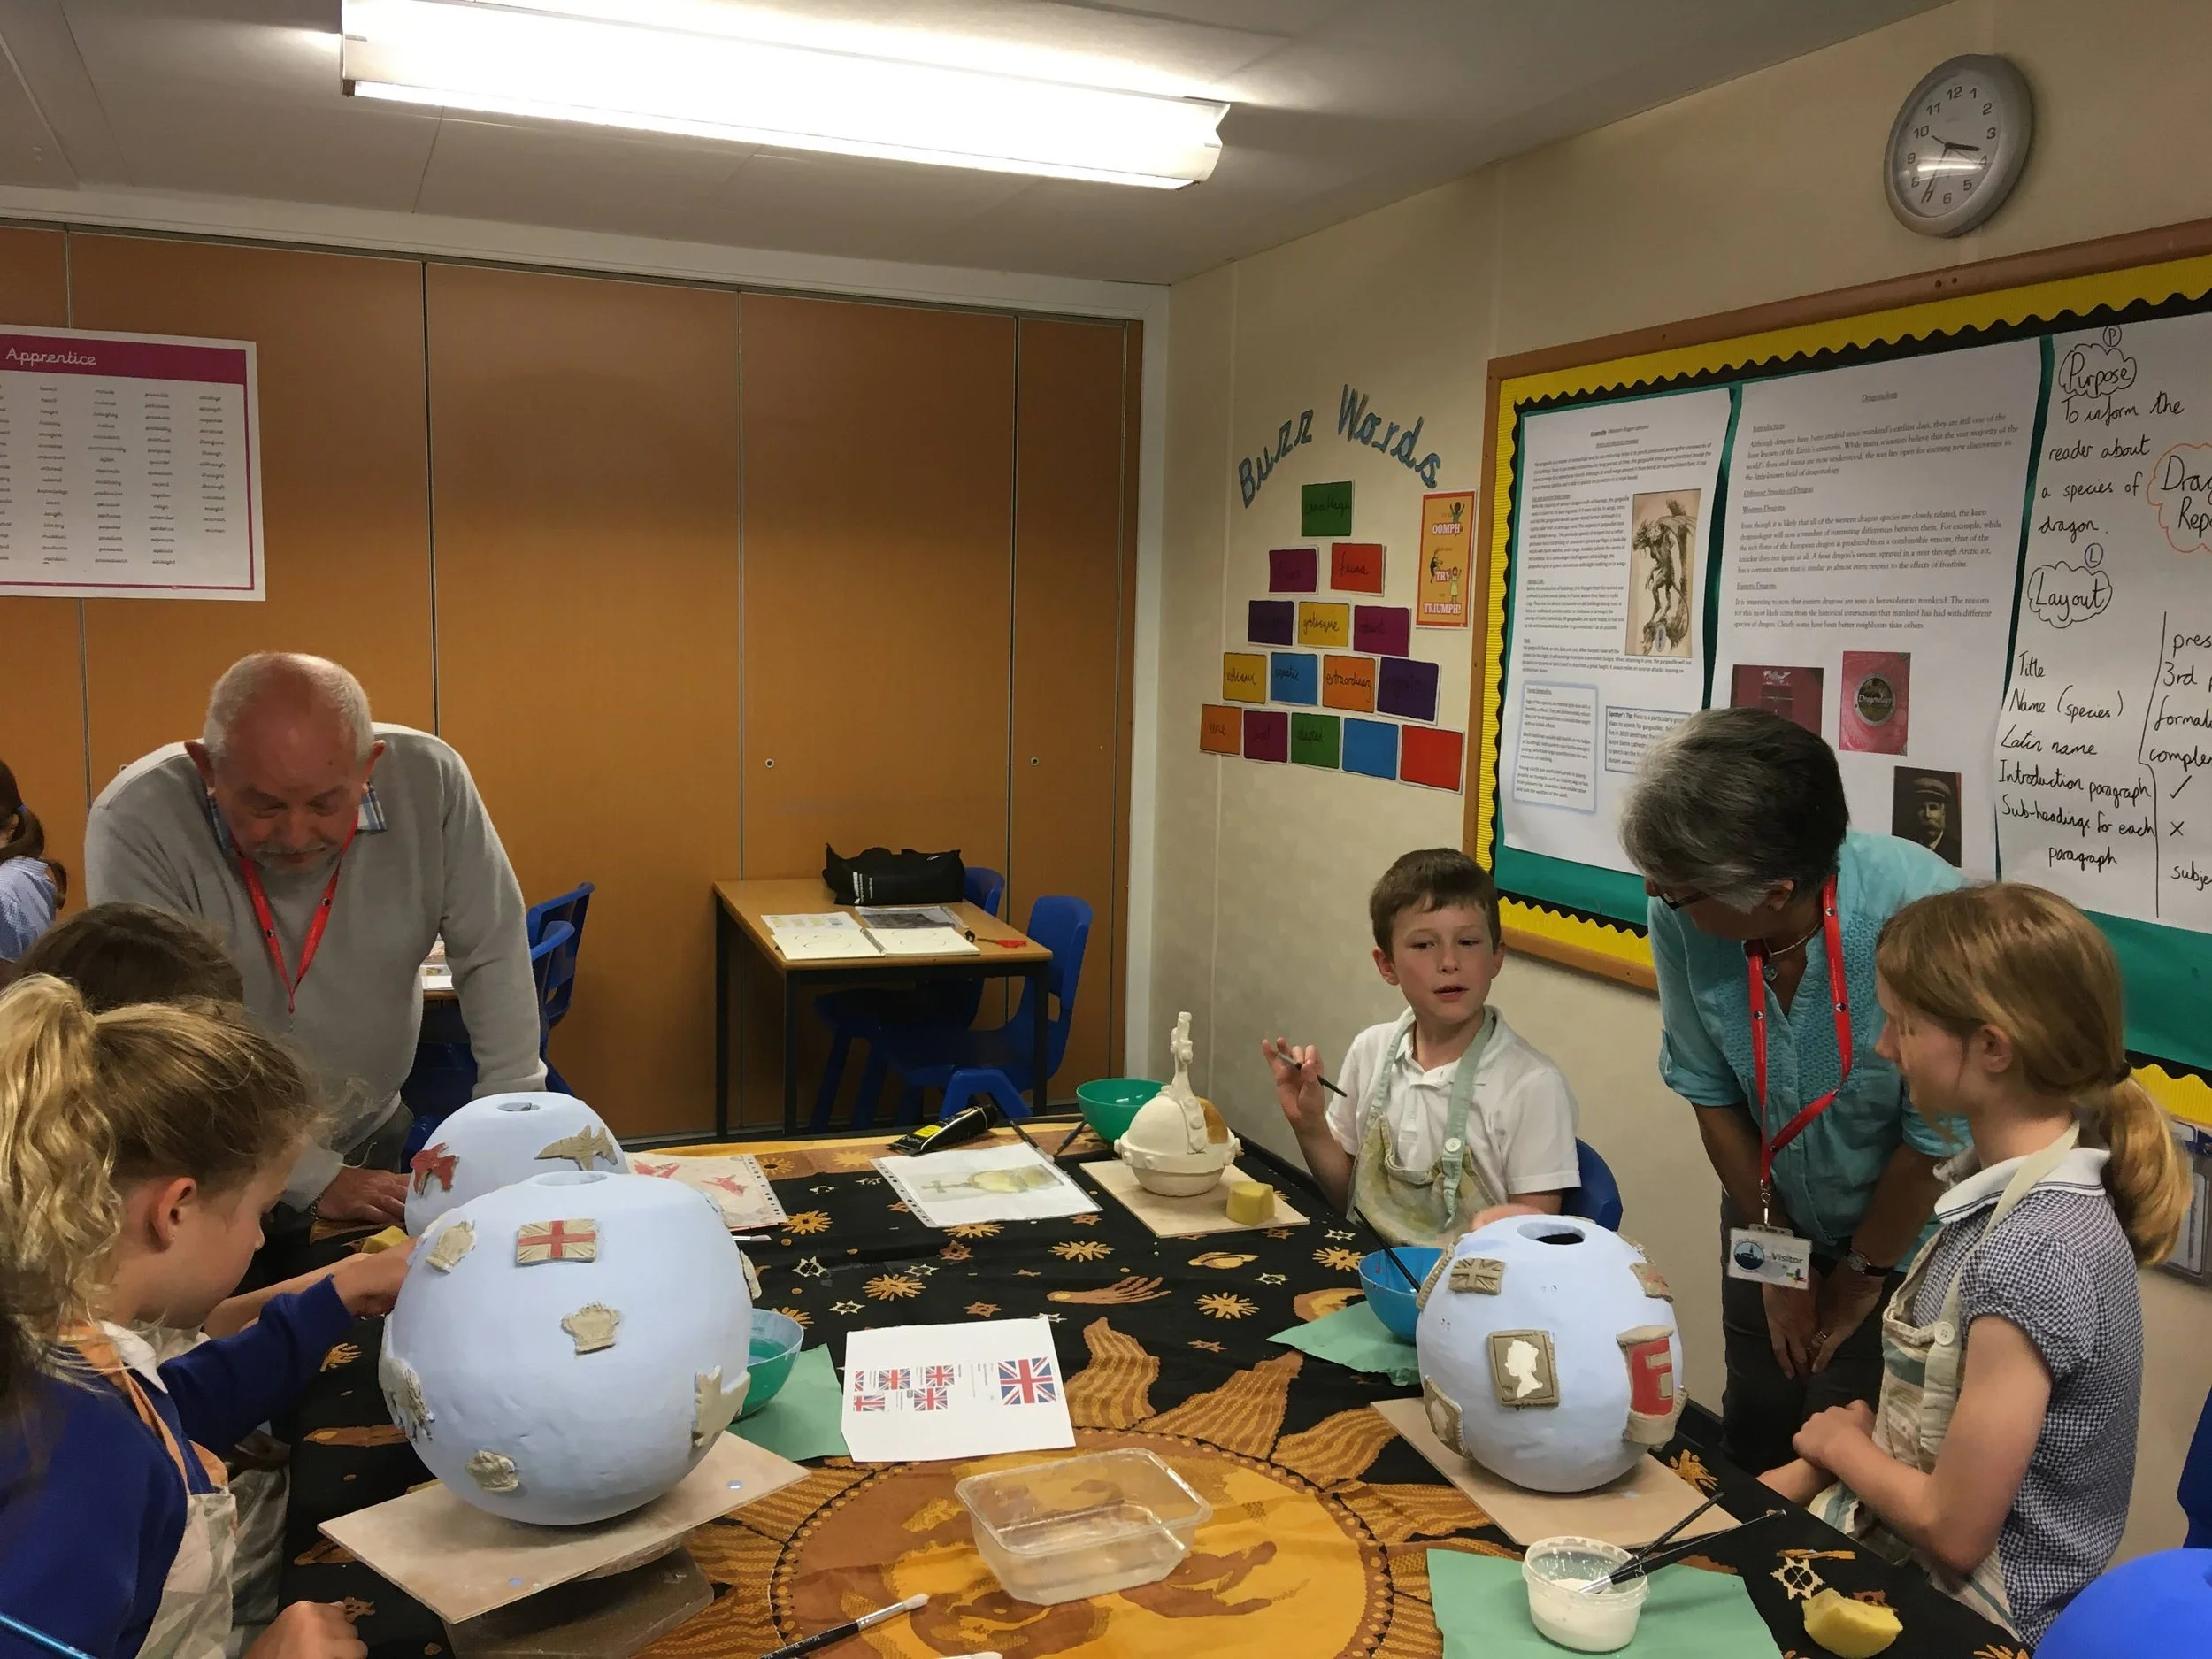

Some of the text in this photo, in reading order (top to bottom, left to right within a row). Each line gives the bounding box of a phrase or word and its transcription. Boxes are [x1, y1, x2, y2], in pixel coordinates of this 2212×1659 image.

[1947, 86, 1962, 99] 12
[1970, 88, 1977, 98] 1
[1926, 103, 1940, 115] 11
[1982, 103, 1992, 114] 2
[1914, 126, 1929, 138] 10
[1987, 127, 1996, 139] 3
[1907, 153, 1916, 164] 9
[1963, 180, 1972, 190] 5
[1943, 193, 1952, 204] 6
[2108, 327, 2117, 340] P
[5, 347, 96, 366] Apprentice
[2069, 352, 2131, 393] Purpose
[2061, 391, 2184, 426] To inform the
[1238, 409, 1313, 507] Buzz
[1337, 383, 1440, 489] Words
[2048, 434, 2150, 461] reader about
[2042, 471, 2143, 502] a species of
[1432, 523, 1460, 534] OOMPH
[2089, 546, 2098, 563] L
[2036, 572, 2105, 623] Layout
[1424, 603, 1462, 614] TRIUMPH!
[2173, 634, 2212, 658] pres
[2018, 650, 2046, 679] Title
[2163, 661, 2197, 687] 3rd
[2008, 684, 2124, 719] Name (species)
[2001, 724, 2098, 756] Latin name
[1999, 759, 2151, 808] Introduction paragraph
[2002, 794, 2156, 837] Sub-headings for each
[2048, 847, 2117, 872] paragraph
[1772, 1252, 1803, 1264] Visitor
